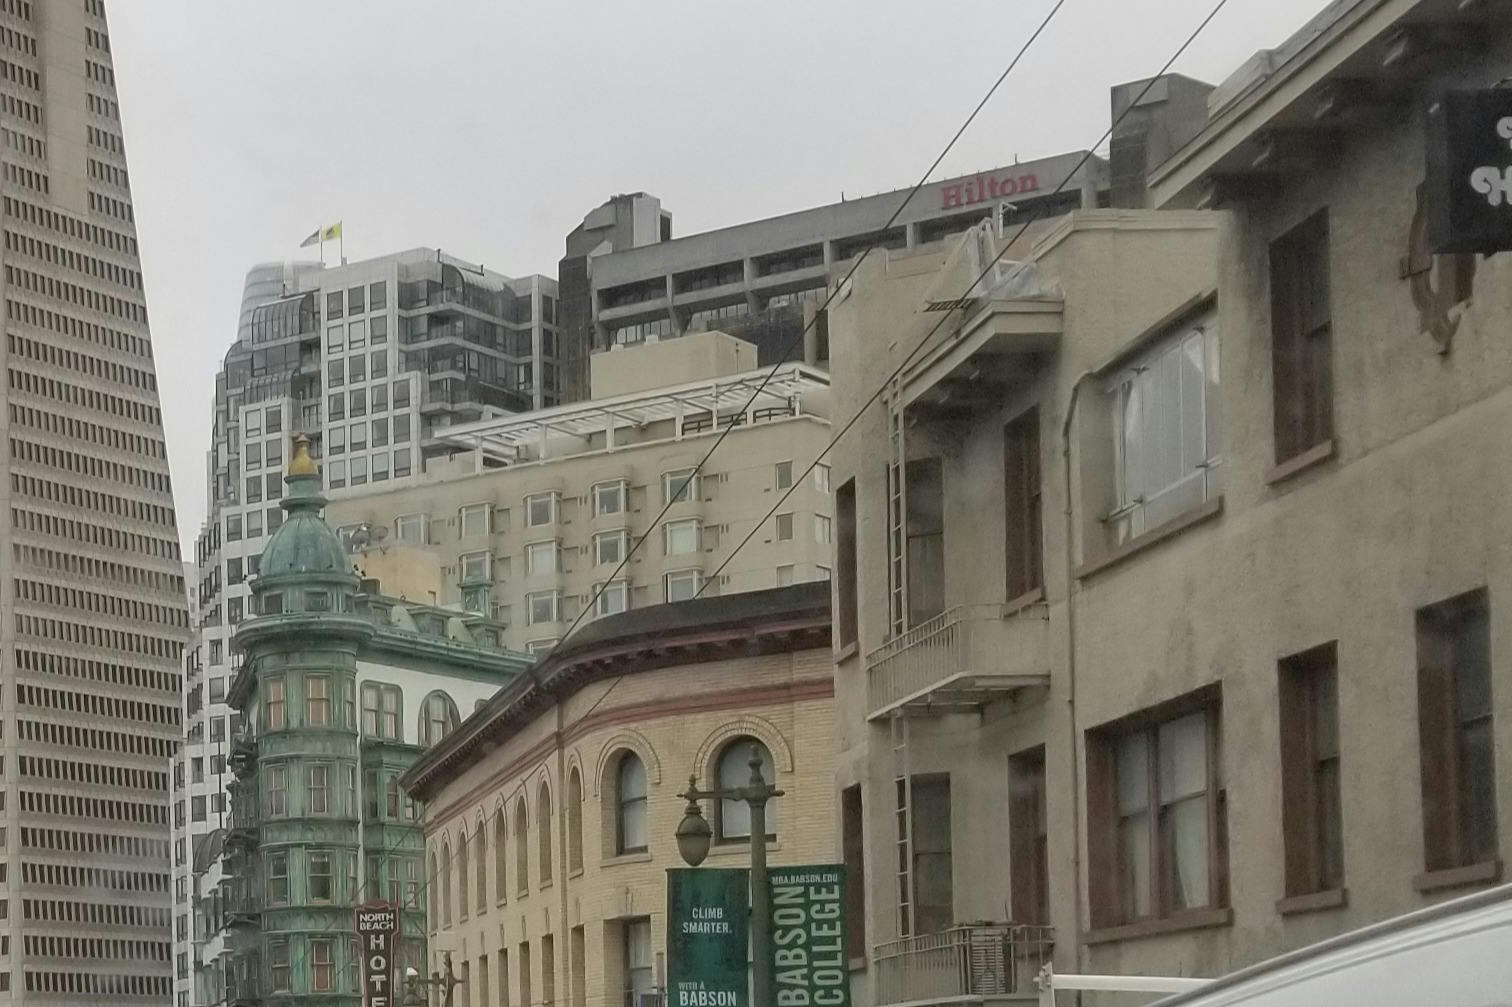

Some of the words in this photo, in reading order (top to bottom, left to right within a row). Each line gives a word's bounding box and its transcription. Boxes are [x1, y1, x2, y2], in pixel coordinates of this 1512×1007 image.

[941, 174, 1039, 210] Hilton
[772, 873, 838, 885] MBA.BABSON.EDU
[359, 912, 394, 922] NORTH
[692, 907, 723, 919] CLIMB
[359, 921, 394, 931] BEACH
[773, 886, 810, 1006] BABSON
[810, 885, 845, 1006] COLLEGE
[678, 982, 697, 991] WITH
[699, 981, 705, 990] A
[679, 991, 737, 1007] BABSON
